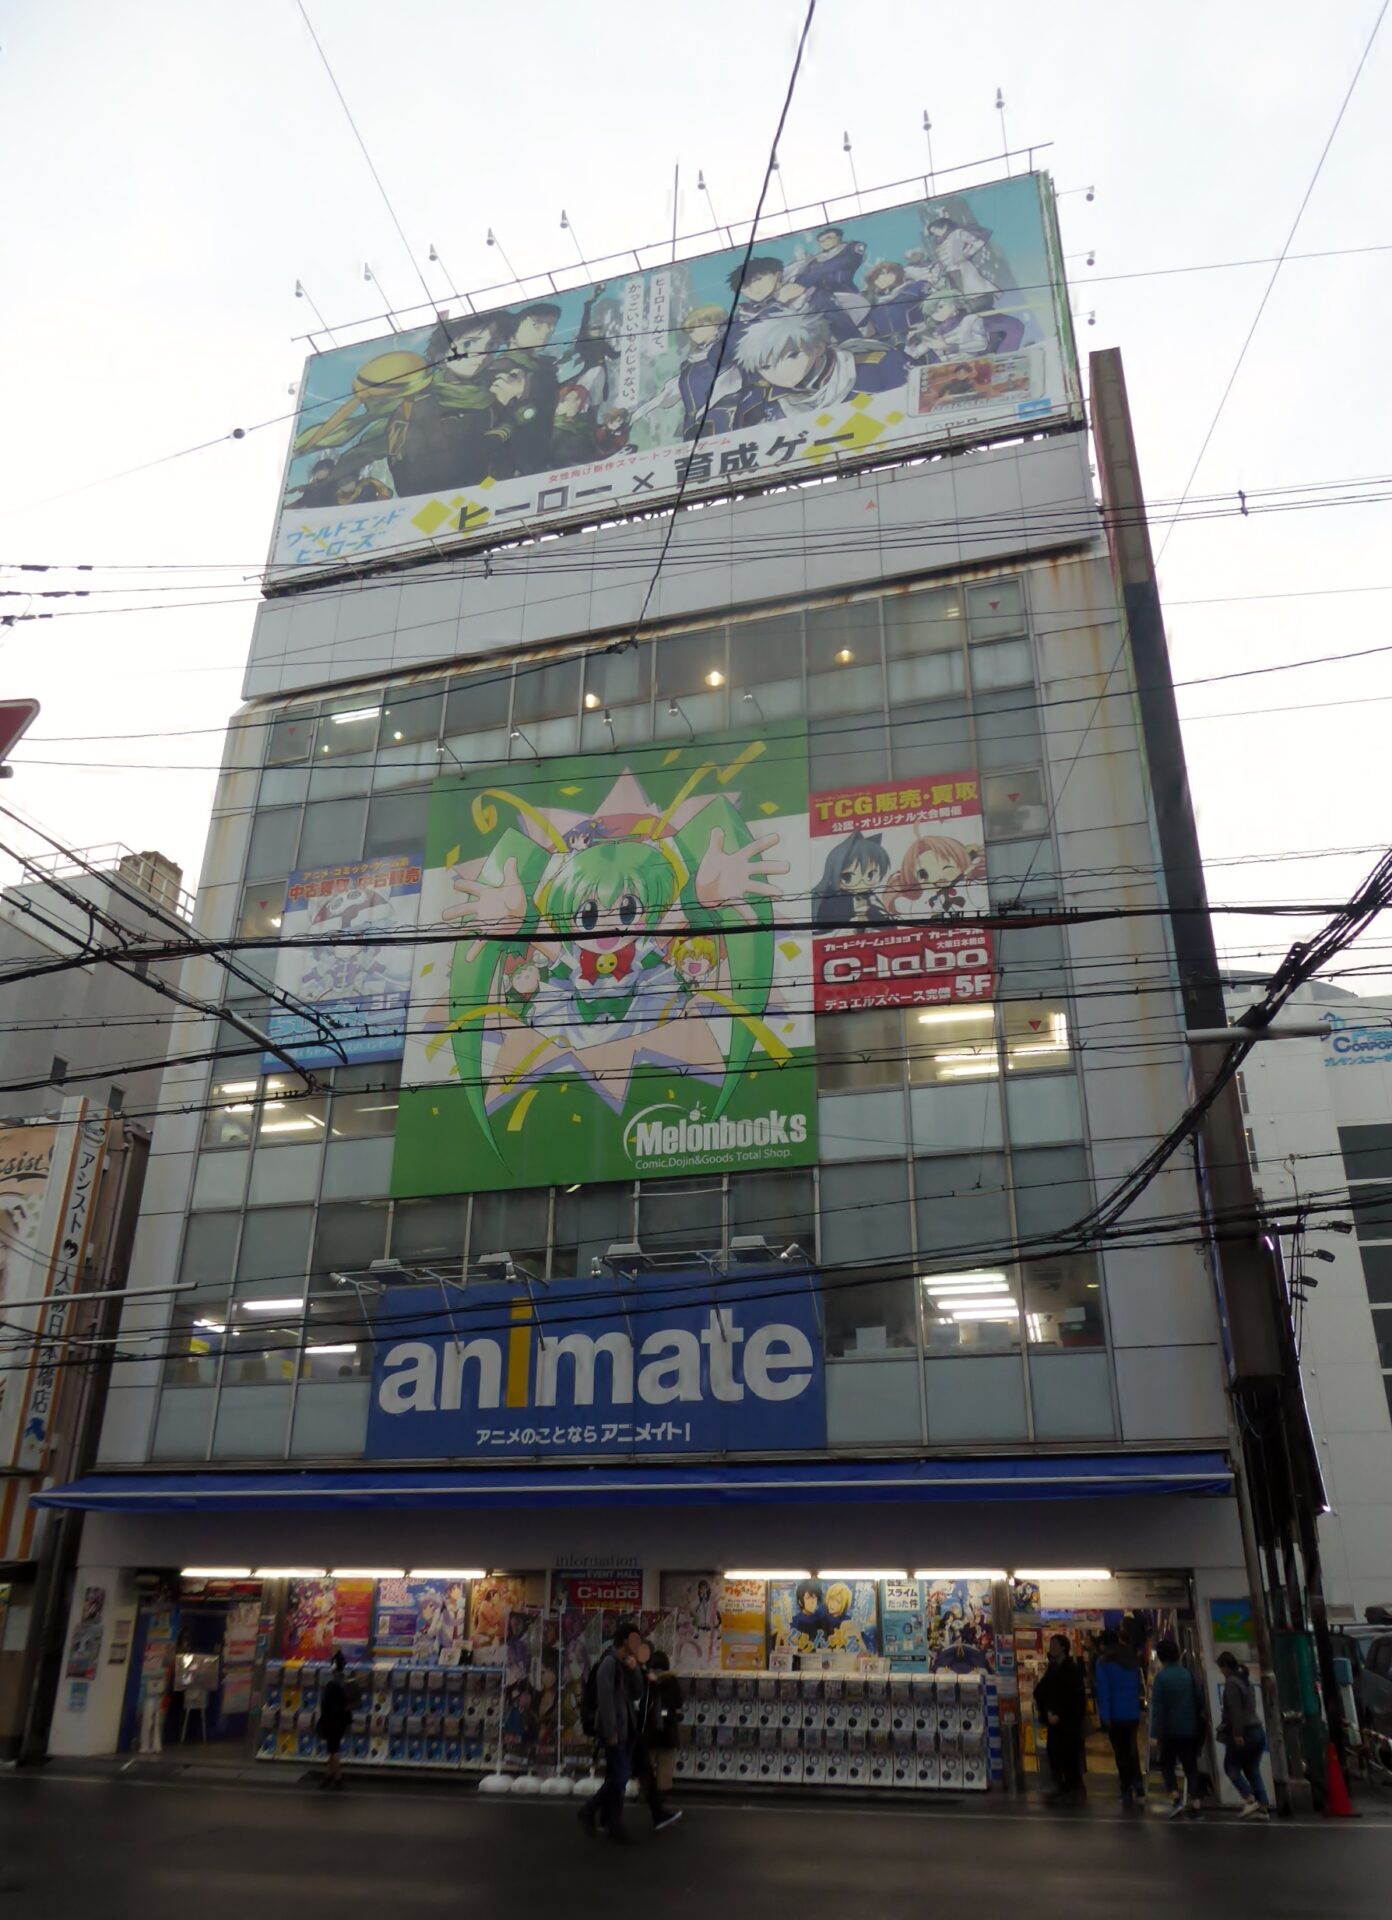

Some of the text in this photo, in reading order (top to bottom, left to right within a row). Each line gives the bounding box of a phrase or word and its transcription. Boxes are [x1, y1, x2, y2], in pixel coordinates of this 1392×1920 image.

[286, 507, 406, 546] ワールドエンド
[296, 531, 386, 563] ヒーローズ
[824, 931, 923, 952] カードゲームショップ
[823, 947, 988, 983] C-labo
[955, 974, 991, 997] 5F
[636, 1110, 807, 1156] Melonbooks
[0, 1151, 49, 1174] sist
[736, 1149, 762, 1161] Total
[71, 1152, 95, 1234] アシスト
[379, 1296, 814, 1415] animate
[475, 1425, 597, 1445] アニメのことなら
[577, 1586, 639, 1599] C-labo
[887, 1588, 918, 1597] スライム
